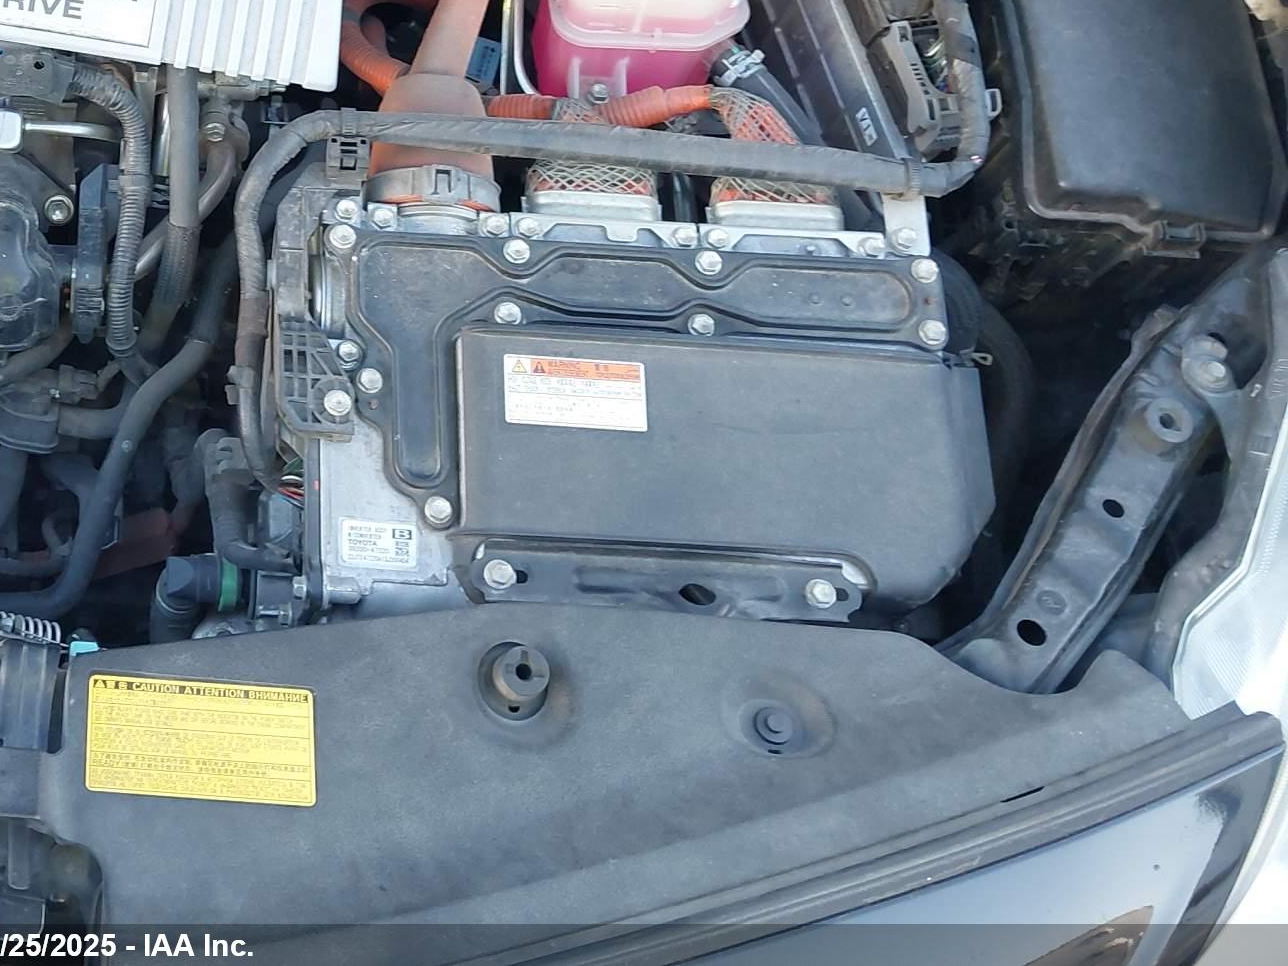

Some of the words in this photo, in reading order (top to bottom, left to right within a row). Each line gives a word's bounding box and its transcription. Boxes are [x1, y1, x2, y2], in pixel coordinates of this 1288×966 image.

[132, 682, 180, 694] CAUTION
[184, 686, 245, 699] ATTENTION
[248, 690, 308, 703] ВНИМАНИЕ
